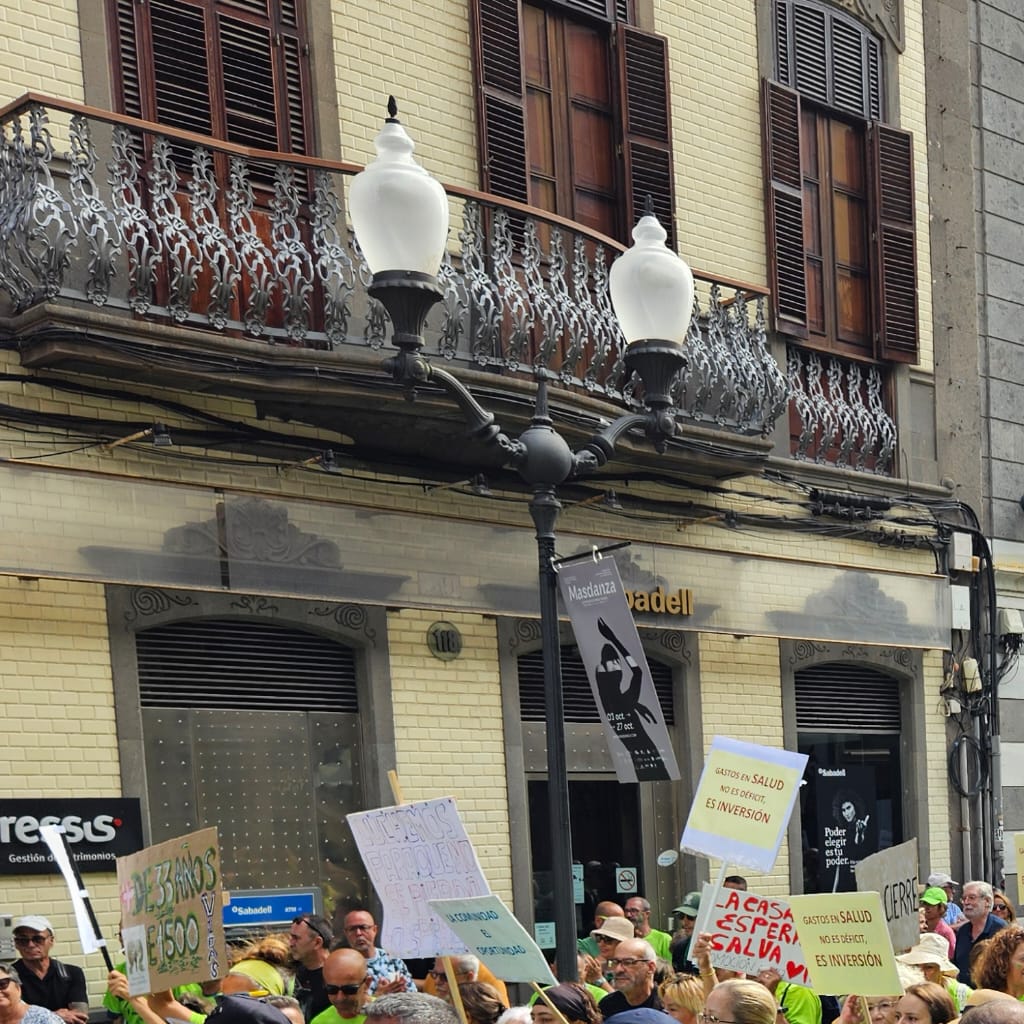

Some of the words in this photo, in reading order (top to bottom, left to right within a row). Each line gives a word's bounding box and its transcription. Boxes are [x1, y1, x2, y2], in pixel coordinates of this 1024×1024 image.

[568, 579, 616, 601] Masdanza
[715, 767, 739, 779] GASTOS
[741, 773, 751, 782] EN
[751, 774, 785, 791] SALUD
[720, 785, 730, 794] NO
[730, 787, 739, 795] ES
[705, 798, 716, 809] ES
[717, 800, 771, 824] INVERSIÓN
[825, 827, 846, 837] Poder
[825, 837, 846, 848] elegir
[8, 852, 46, 863] Gestión
[47, 851, 57, 862] d
[73, 852, 117, 861] trimonios
[826, 856, 849, 868] poder.
[883, 876, 918, 923] CIERRE
[238, 906, 272, 916] Sabadell
[803, 915, 829, 925] GASTOS
[830, 915, 839, 923] EN
[839, 910, 872, 923] SALUD
[819, 935, 831, 944] NO
[832, 935, 841, 944] ES
[816, 954, 828, 967] ES
[829, 952, 883, 967] INVERSIÓN
